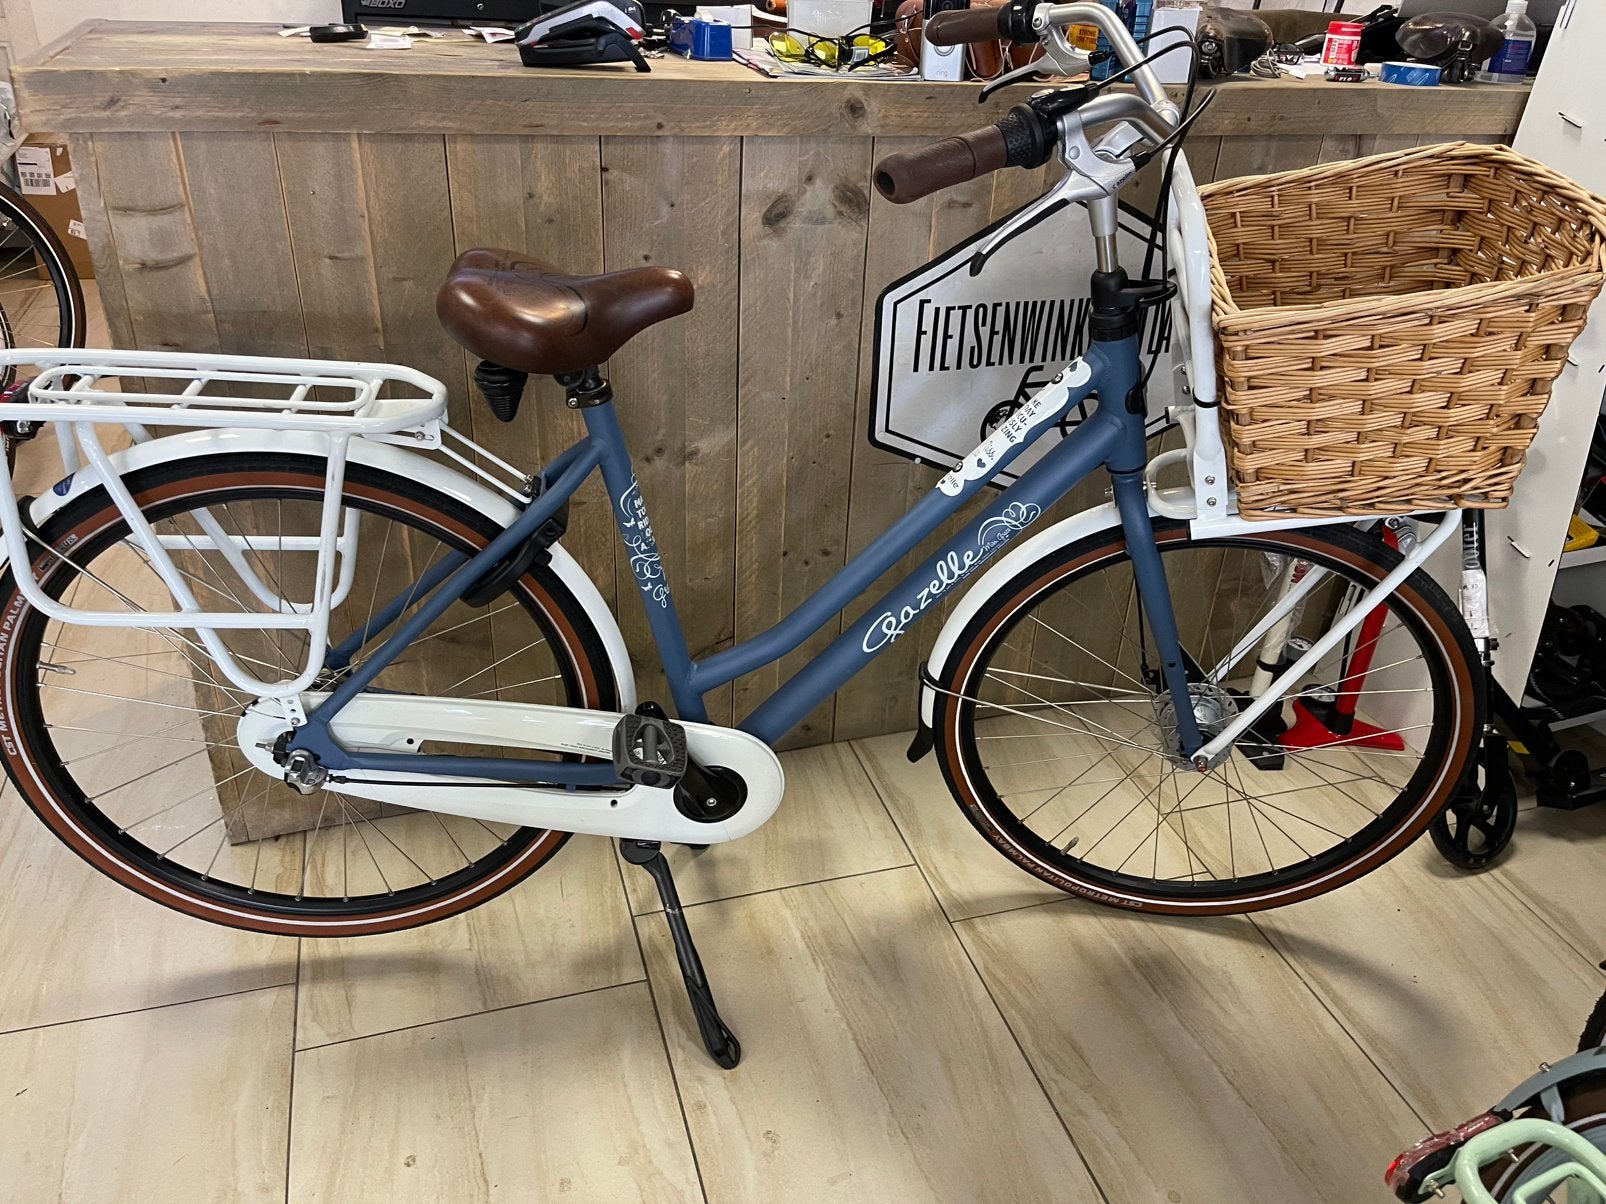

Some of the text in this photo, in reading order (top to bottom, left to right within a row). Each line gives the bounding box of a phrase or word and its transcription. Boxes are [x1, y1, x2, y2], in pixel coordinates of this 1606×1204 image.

[912, 298, 1091, 373] FIETSENWINK
[862, 548, 984, 653] Gazelle
[4, 734, 18, 756] CST
[1034, 867, 1120, 904] METROPOLITAN
[1120, 899, 1144, 909] CST
